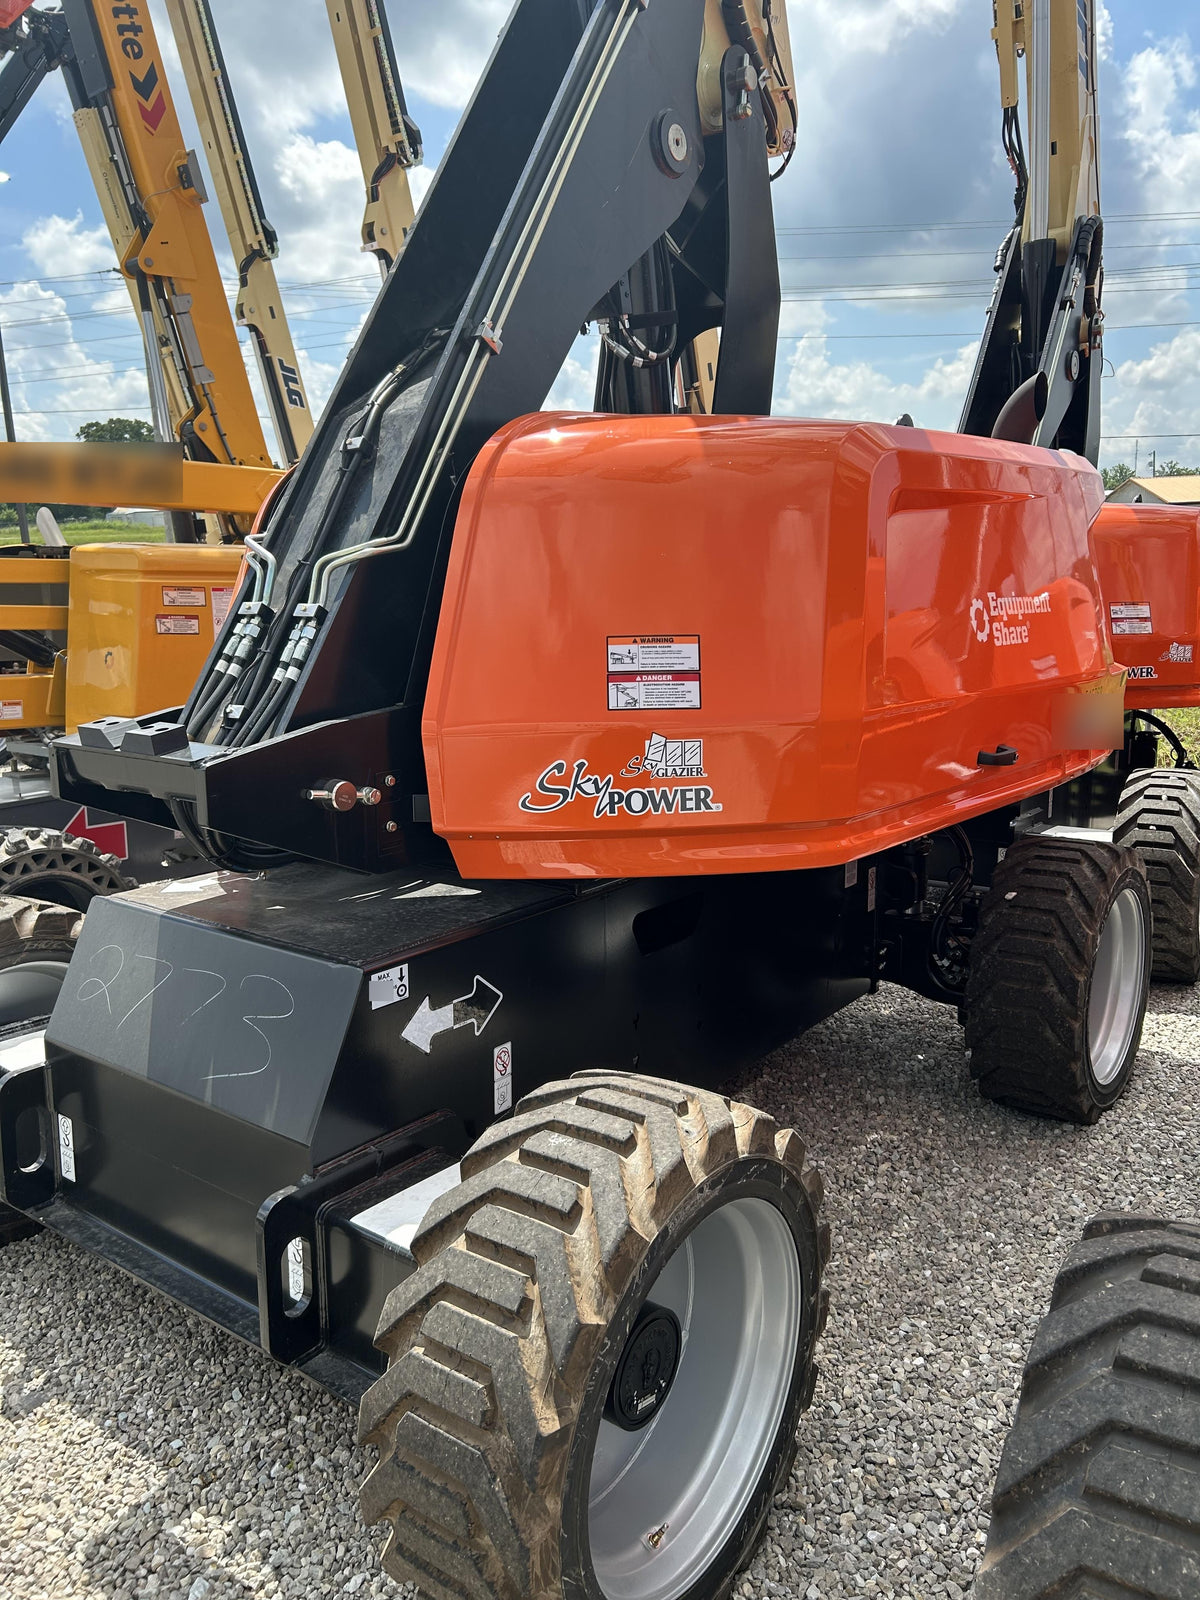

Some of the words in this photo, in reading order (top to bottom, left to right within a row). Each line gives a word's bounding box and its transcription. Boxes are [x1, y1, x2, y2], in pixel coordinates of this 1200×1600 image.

[111, 0, 144, 60] tte
[276, 357, 306, 409] JLG
[987, 591, 1051, 621] Equipment
[992, 621, 1029, 647] Share
[1127, 667, 1154, 679] WER
[378, 972, 390, 981] MAX
[76, 944, 295, 1080] 2773
